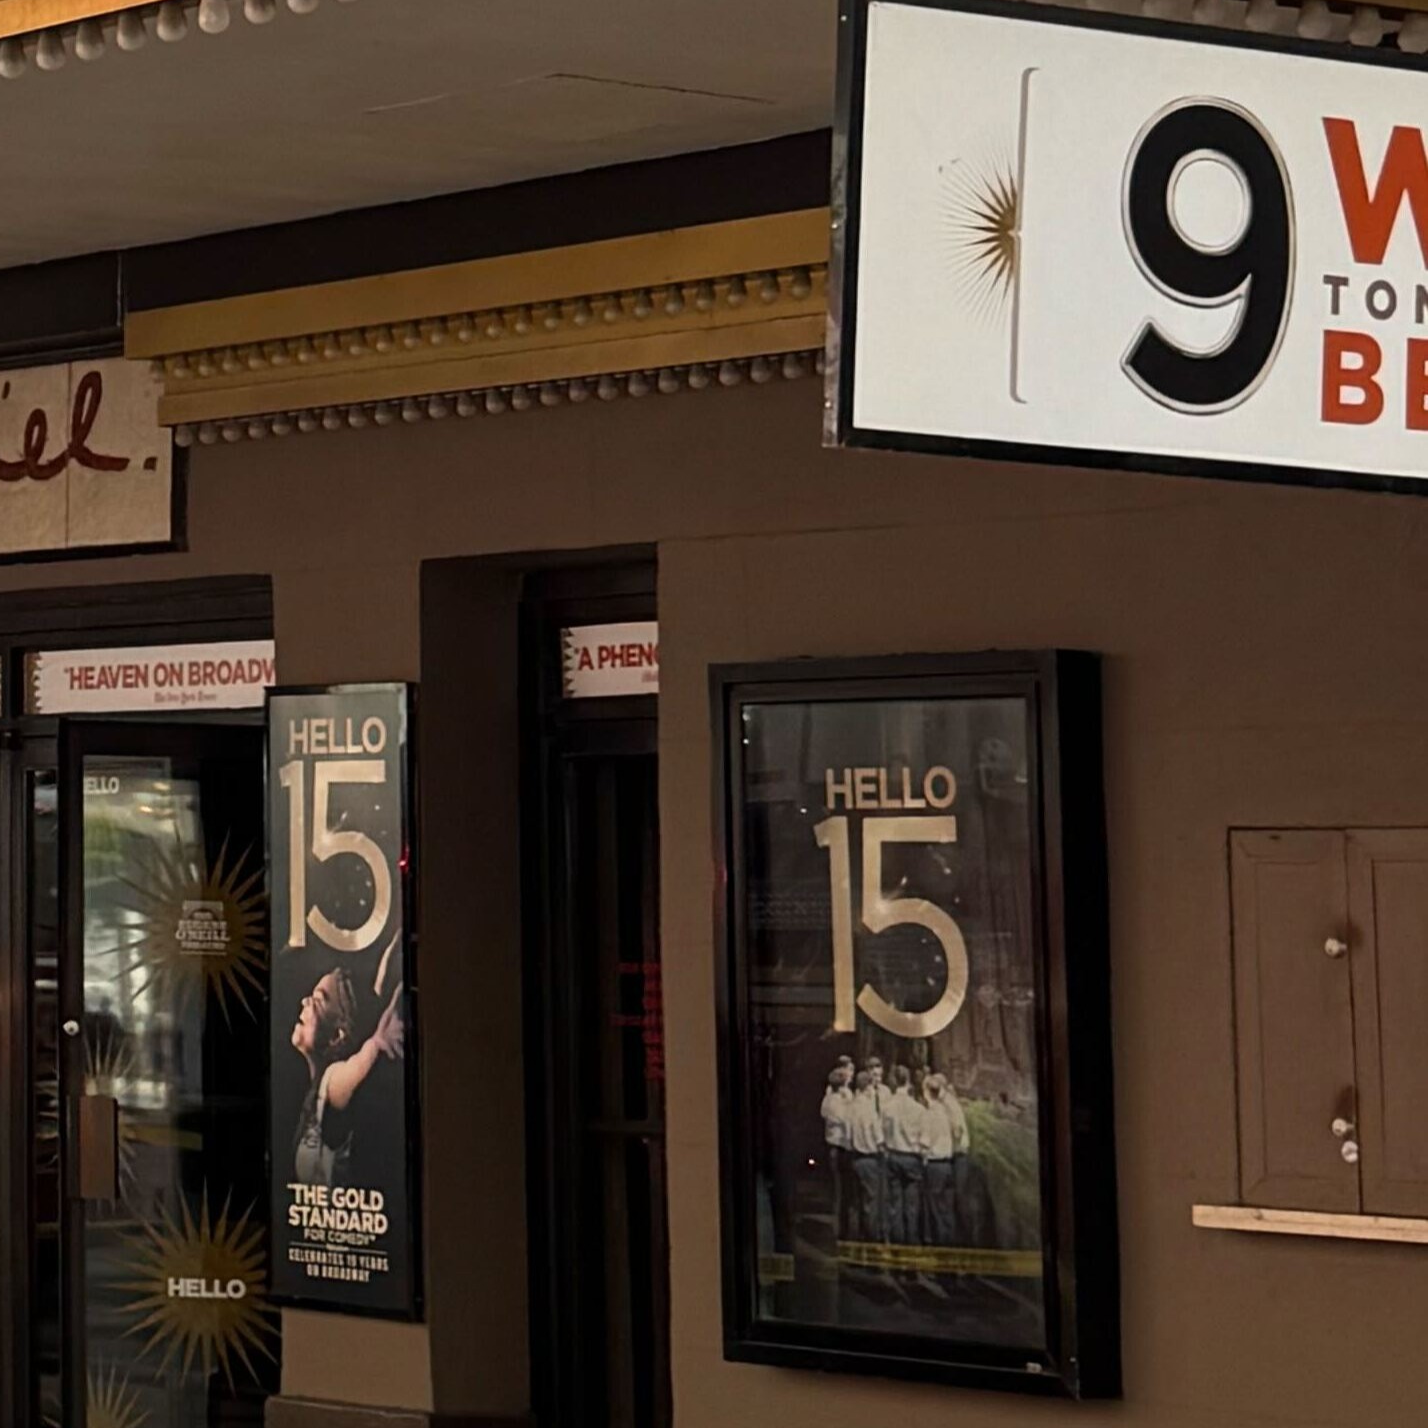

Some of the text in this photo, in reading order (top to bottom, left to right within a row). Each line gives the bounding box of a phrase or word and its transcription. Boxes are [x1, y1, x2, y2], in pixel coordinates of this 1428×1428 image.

[1121, 95, 1296, 415] 9
[153, 663, 183, 688] ON
[289, 716, 387, 756] HELLO
[85, 776, 120, 794] ELLO
[825, 766, 957, 812] HELLO
[279, 759, 392, 952] 15
[813, 815, 969, 1039] 15
[332, 1187, 384, 1211] GOLD
[288, 1204, 388, 1234] STANDARD
[167, 1277, 246, 1299] HELLO
